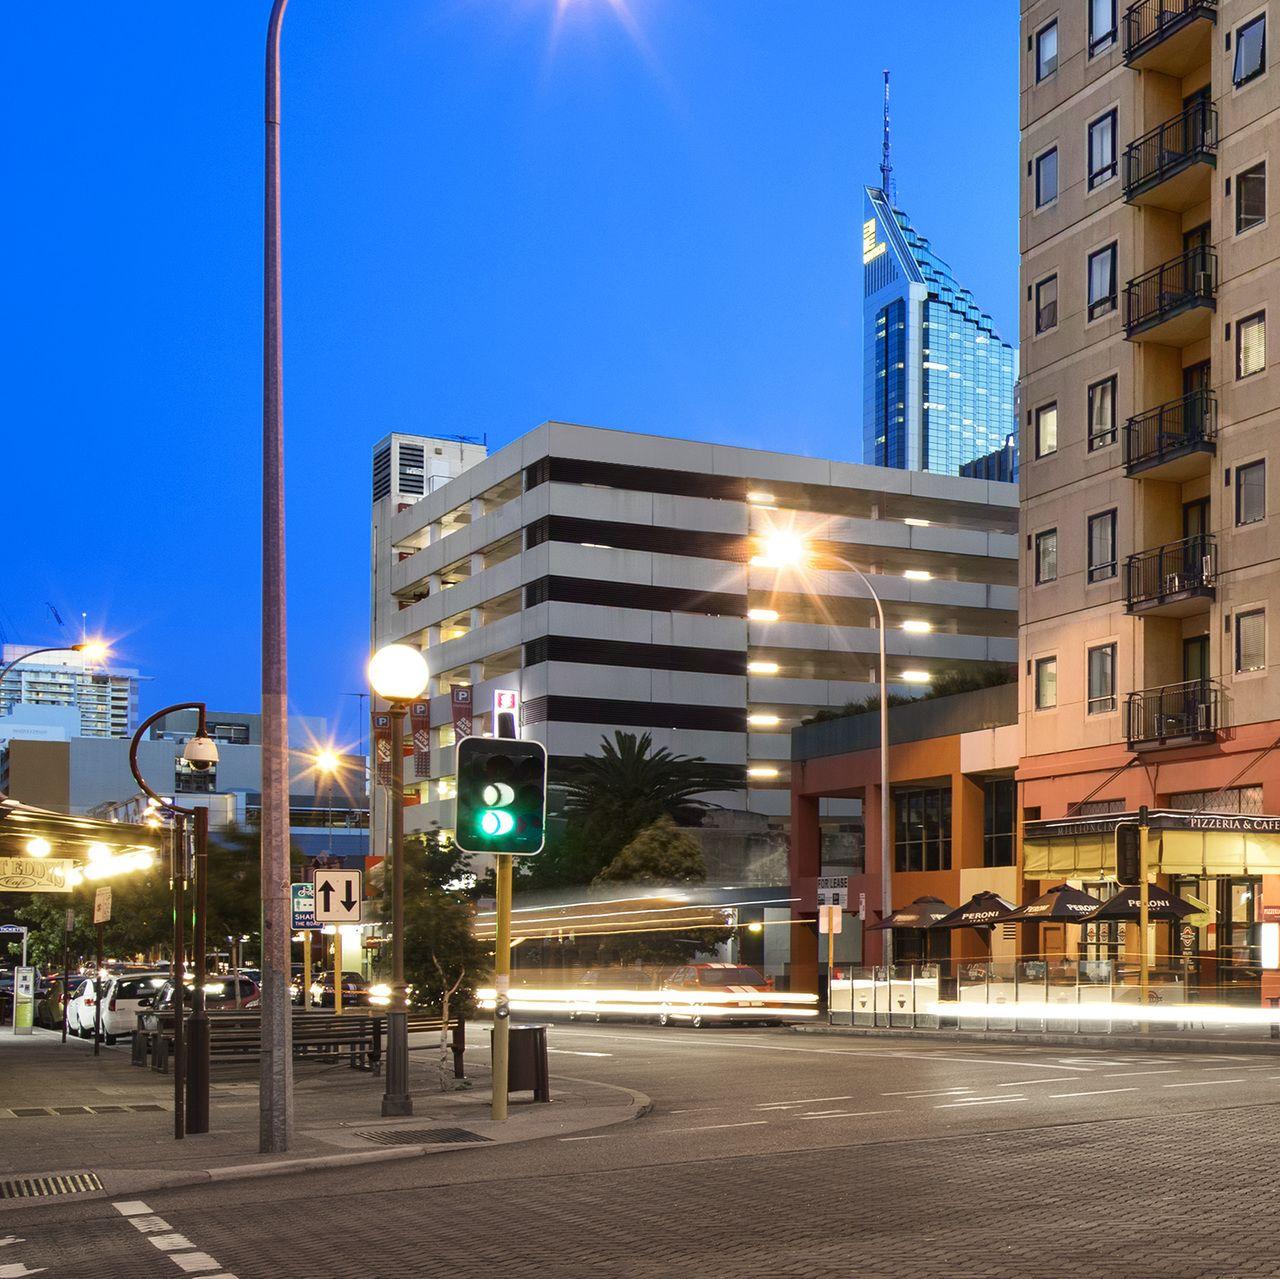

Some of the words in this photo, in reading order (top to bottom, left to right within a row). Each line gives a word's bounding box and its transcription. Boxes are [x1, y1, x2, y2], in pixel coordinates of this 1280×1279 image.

[1190, 818, 1240, 828] PIZZERIA
[1243, 819, 1252, 829] &
[1254, 819, 1280, 830] CAFE
[818, 878, 829, 888] FOR
[830, 877, 848, 888] LEASE
[961, 910, 1000, 920] PERONI
